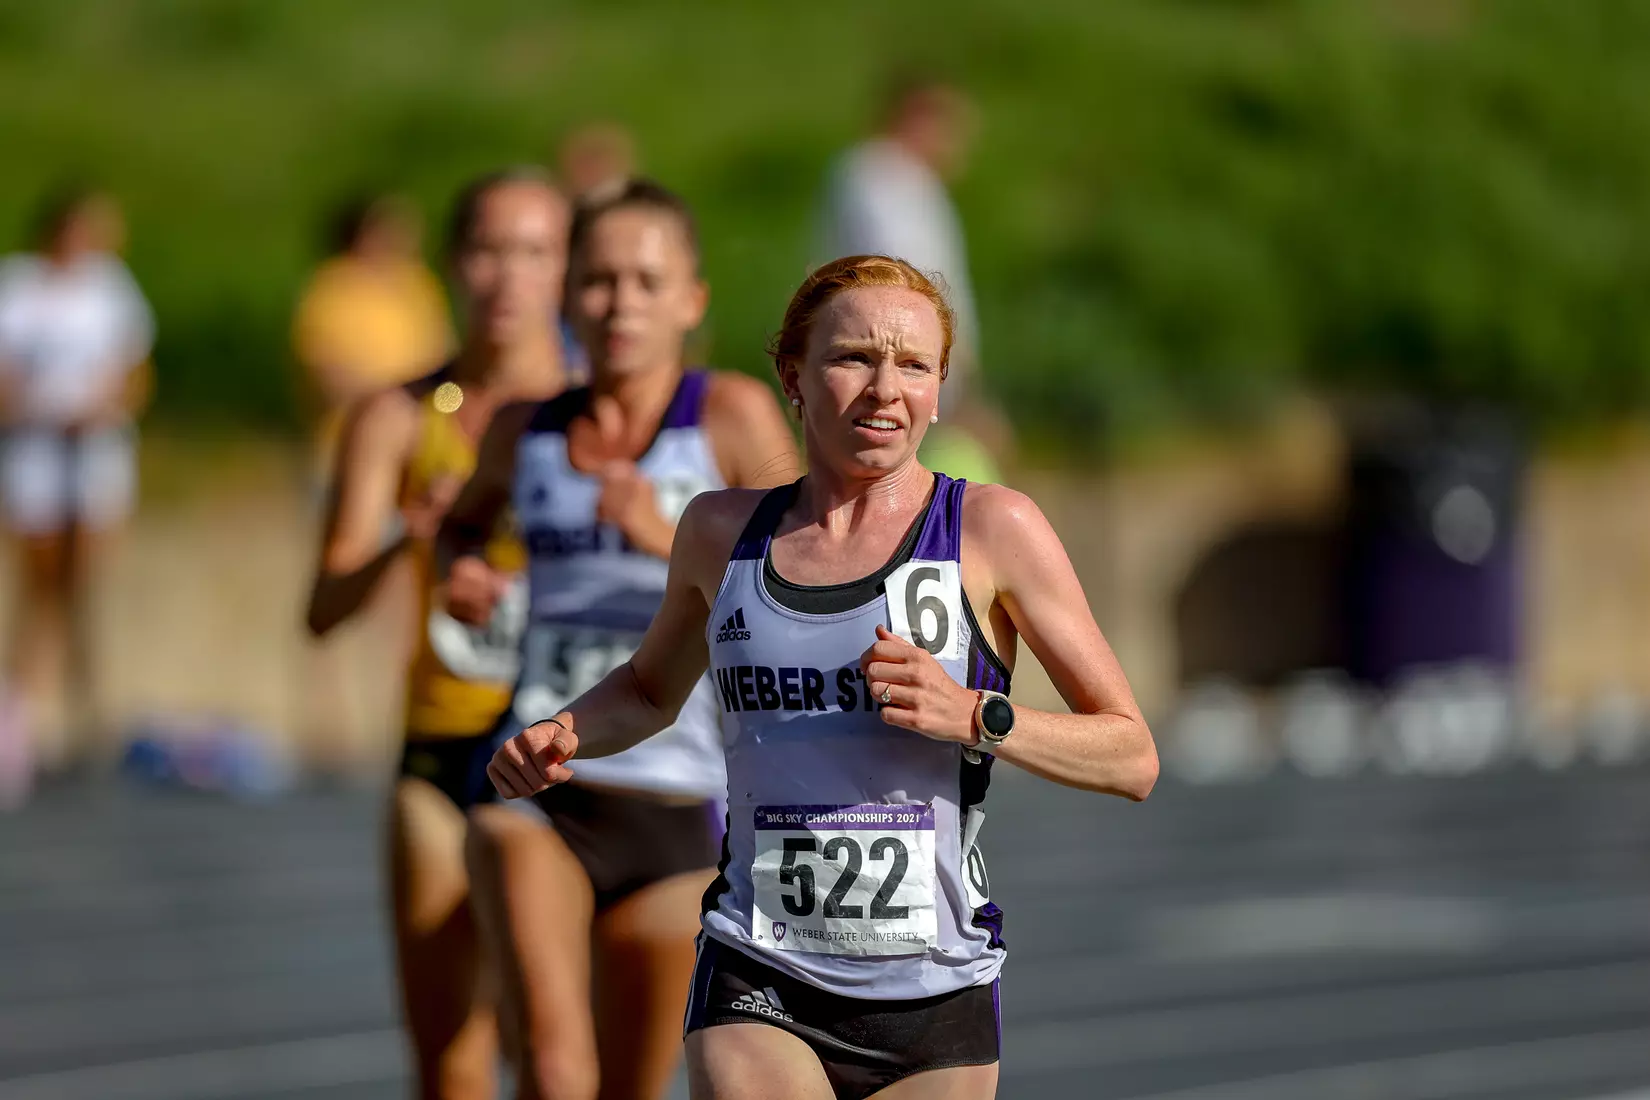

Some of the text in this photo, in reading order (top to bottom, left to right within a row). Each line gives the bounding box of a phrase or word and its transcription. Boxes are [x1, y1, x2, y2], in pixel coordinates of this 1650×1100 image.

[905, 566, 950, 655] 6
[716, 628, 751, 644] adidas
[717, 666, 881, 713] WEBER ST
[766, 812, 920, 823] BIG SKY CHAMPIONSHIPS 2021
[779, 836, 909, 919] 522
[792, 927, 919, 942] WEBER STATE UNIVERSITY
[731, 999, 794, 1023] adidas
